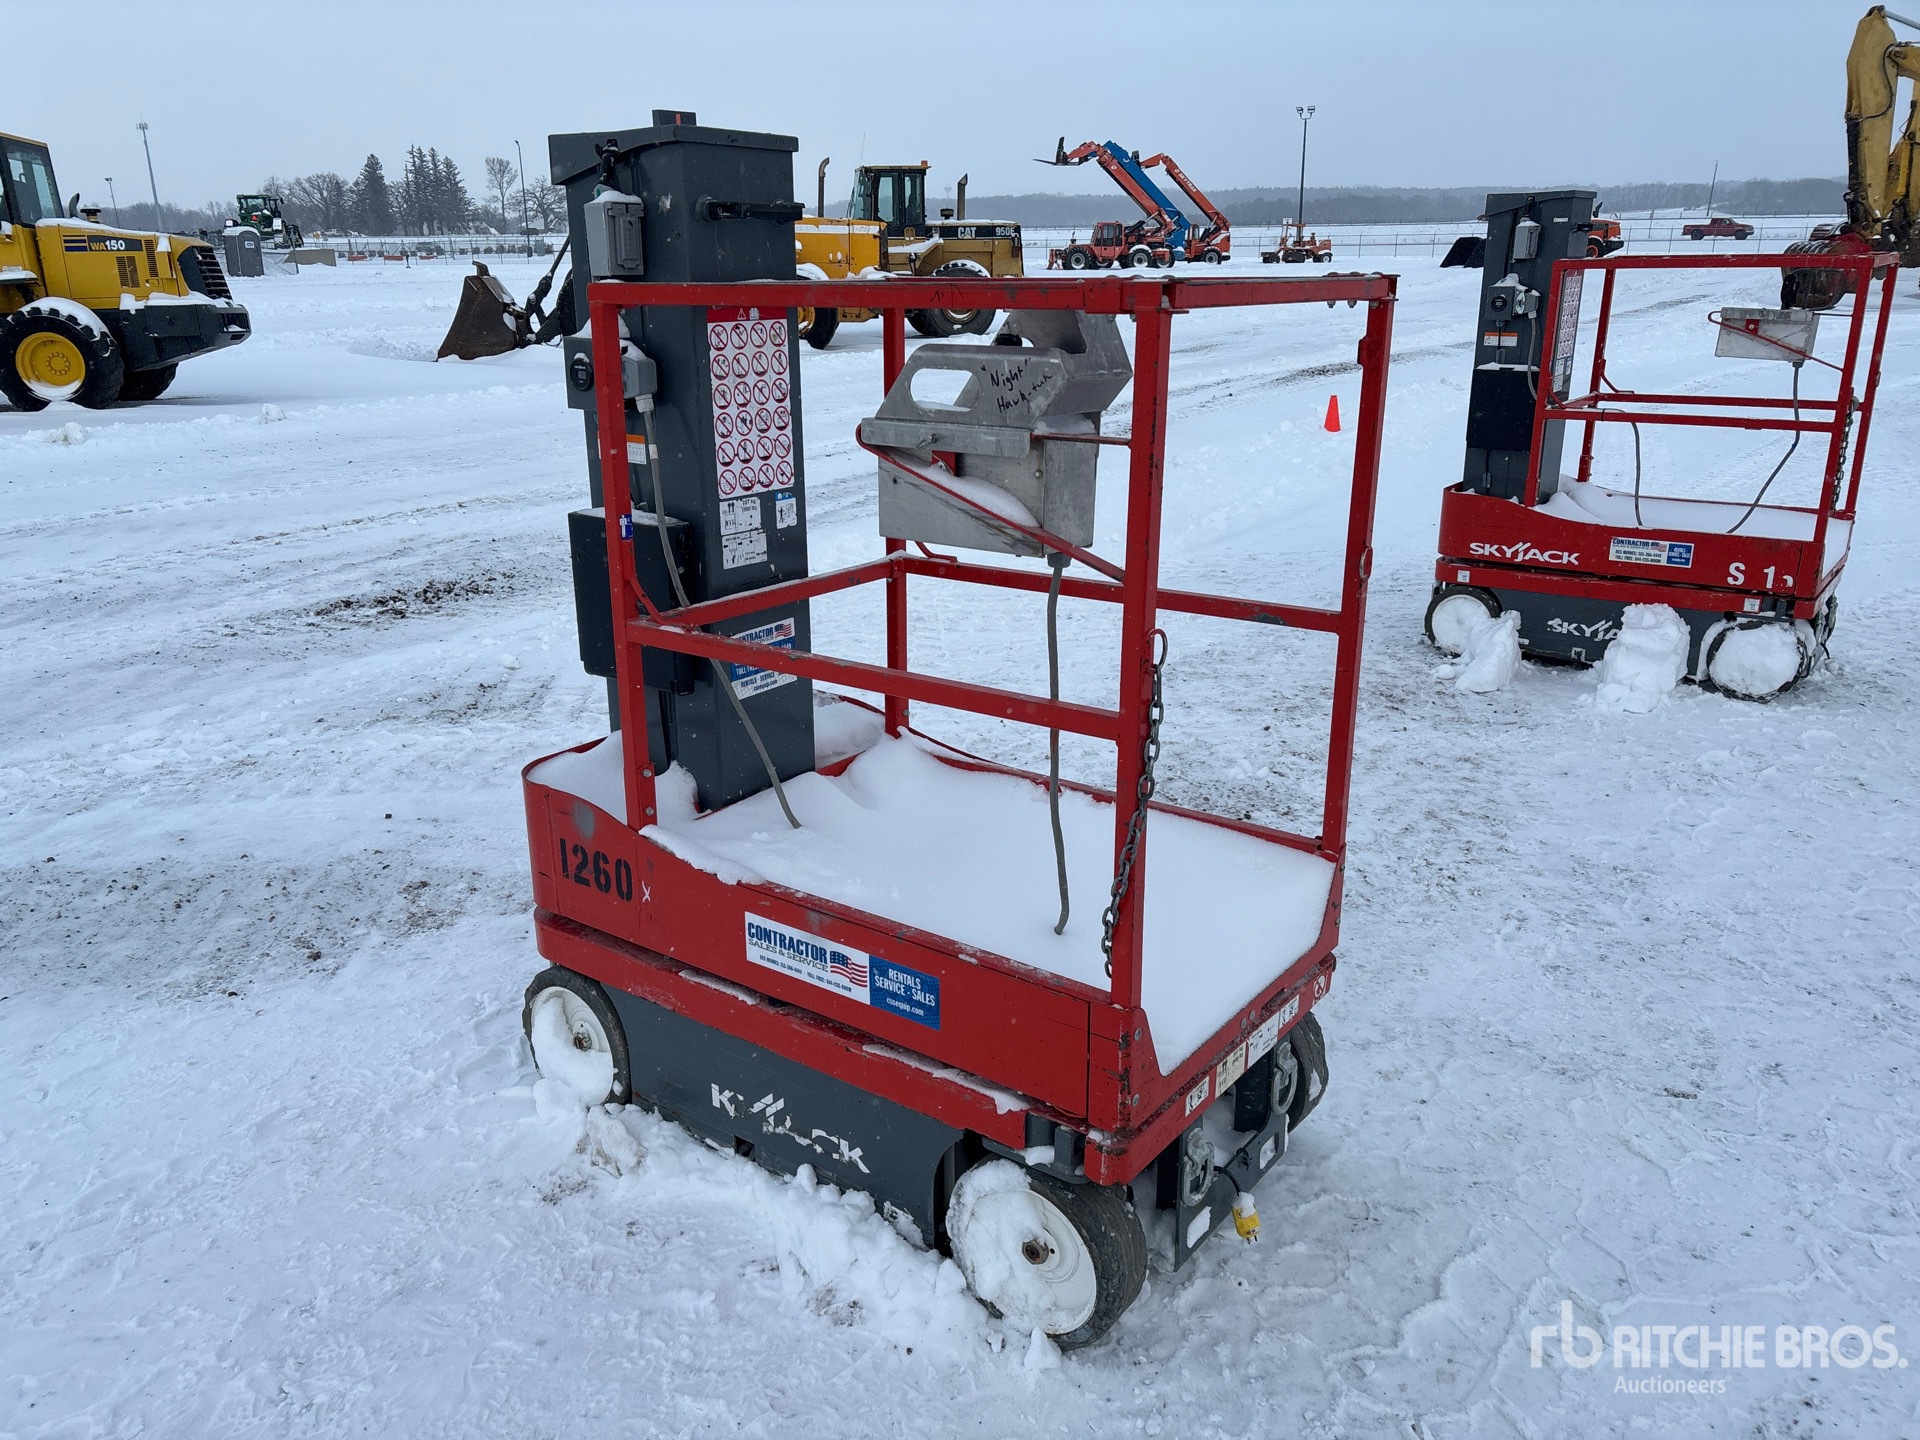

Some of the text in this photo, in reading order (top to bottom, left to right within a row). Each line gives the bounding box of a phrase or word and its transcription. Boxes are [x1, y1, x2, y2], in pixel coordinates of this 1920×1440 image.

[89, 239, 126, 251] WA150
[957, 227, 977, 239] CAT
[1469, 541, 1581, 566] SKYJACK
[559, 837, 633, 902] 1260
[747, 922, 829, 964] CONTRACTOR
[748, 938, 777, 954] SALES
[786, 951, 829, 973] SERVICE
[874, 975, 936, 1007] SERVICE SALES
[888, 968, 922, 989] RENTALS
[886, 997, 924, 1017] cssequip.com
